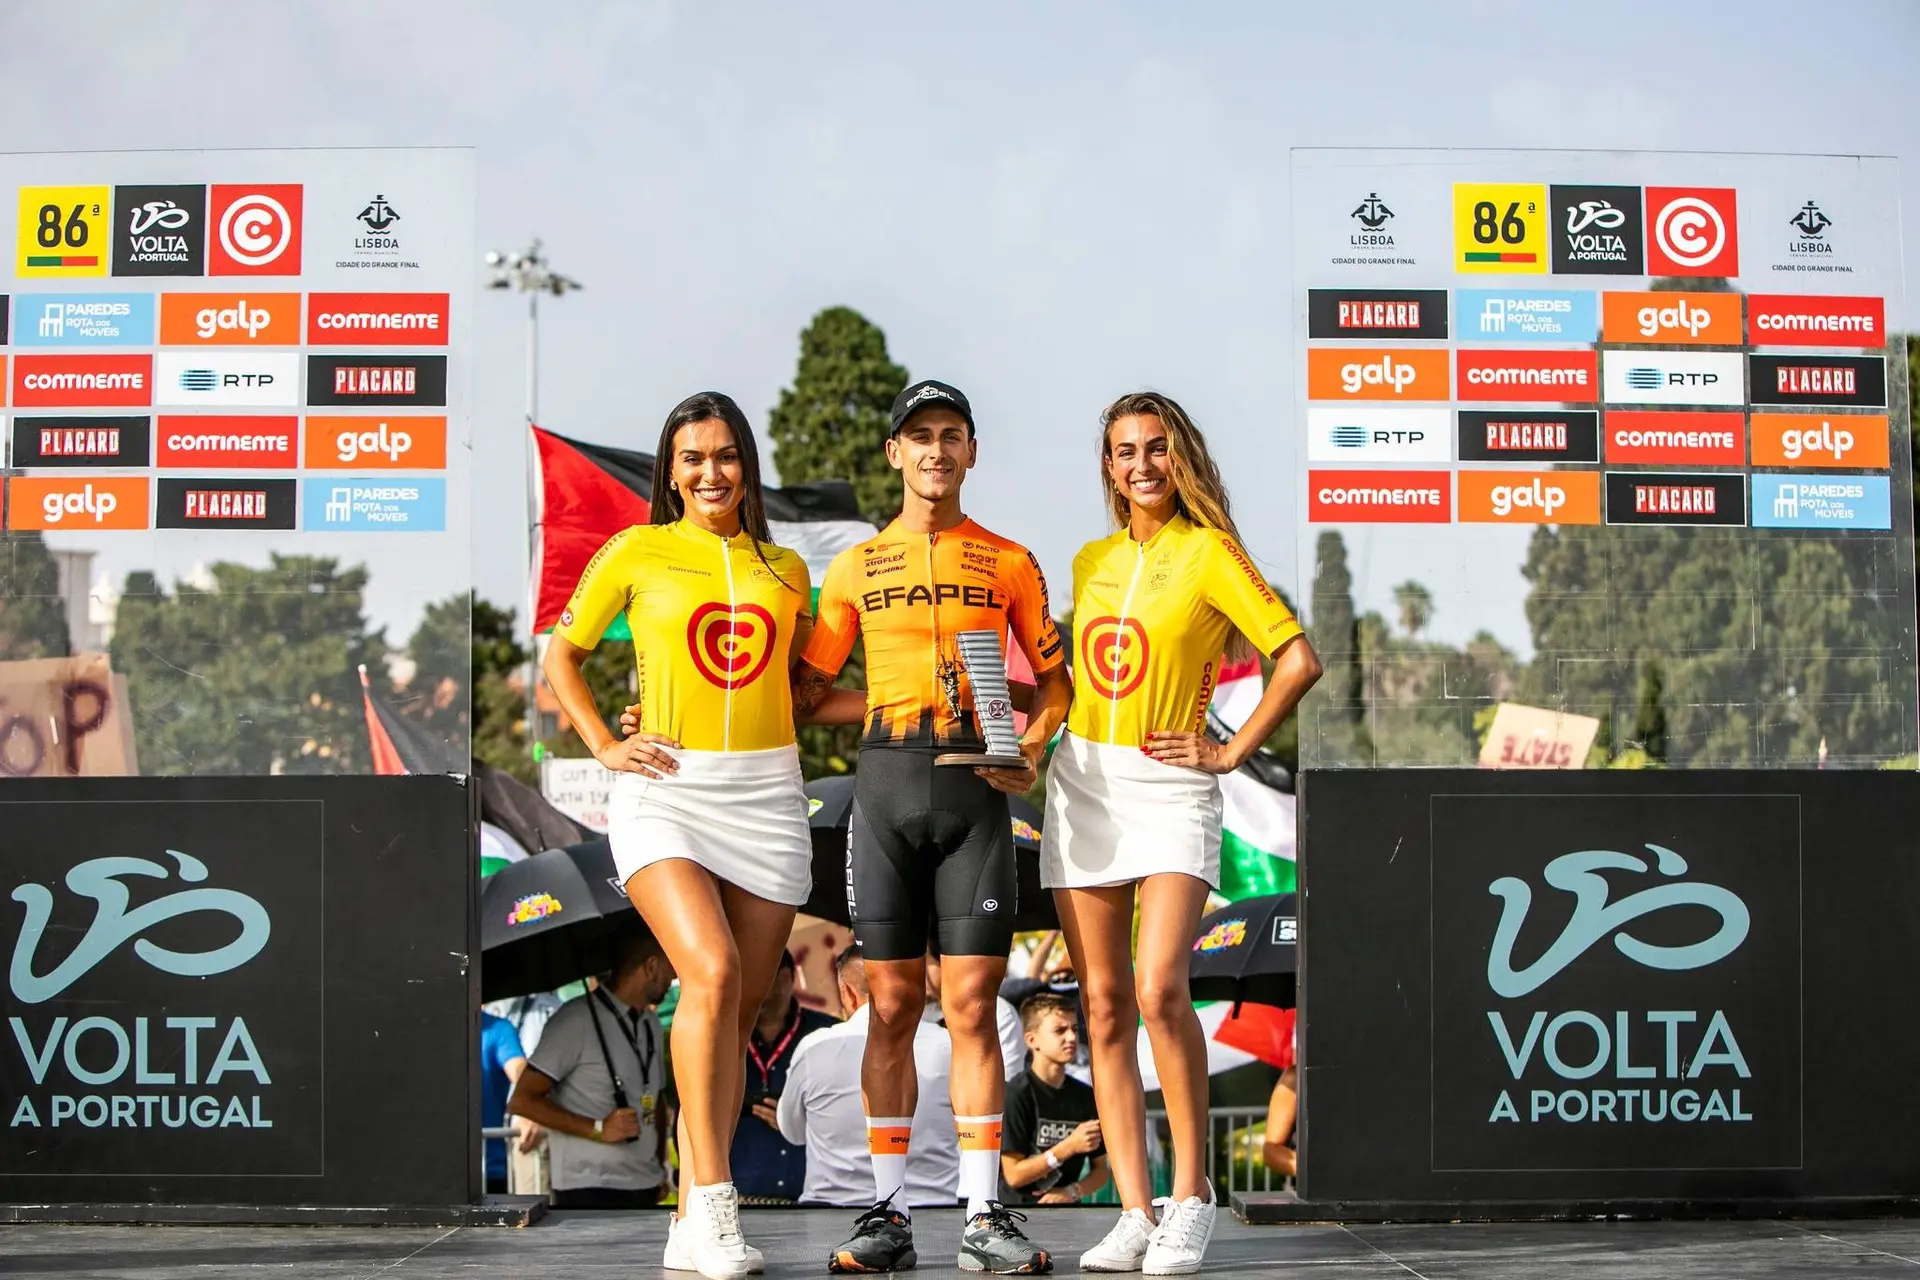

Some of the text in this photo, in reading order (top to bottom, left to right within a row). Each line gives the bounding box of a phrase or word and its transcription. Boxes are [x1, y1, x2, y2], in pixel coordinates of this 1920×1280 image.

[130, 236, 188, 252] VOLTA
[355, 239, 399, 248] LISBOA
[1351, 235, 1394, 245] LISBOA
[1567, 235, 1627, 251] VOLTA
[1790, 243, 1832, 253] LISBOA
[139, 253, 188, 261] PORTUGAL
[1578, 252, 1627, 261] PORTUGAL
[66, 304, 130, 315] PAREDES
[1507, 300, 1571, 312] PAREDES
[196, 301, 270, 337] galp
[318, 313, 438, 329] CONTINENTE
[1340, 302, 1419, 327] PLACARD
[1507, 314, 1535, 323] ROTA
[1638, 300, 1710, 337] galp
[1757, 314, 1873, 331] CONTINENTE
[66, 319, 93, 328] ROTA
[24, 374, 143, 389] CONTINENTE
[224, 374, 274, 387] RTP
[335, 368, 415, 393] PLACARD
[1341, 356, 1415, 393] galp
[1467, 368, 1587, 384] CONTINENTE
[1669, 373, 1718, 386] RTP
[1778, 367, 1855, 393] PLACARD
[41, 429, 119, 455] PLACARD
[168, 435, 288, 451] CONTINENTE
[337, 424, 411, 461] galp
[1374, 431, 1424, 444] RTP
[1487, 423, 1566, 449] PLACARD
[1615, 431, 1733, 448] CONTINENTE
[1782, 422, 1854, 459] galp
[353, 488, 419, 500] PAREDES
[1318, 488, 1440, 505] CONTINENTE
[1491, 478, 1565, 515] galp
[1800, 485, 1863, 497] PAREDES
[43, 485, 116, 522] galp
[186, 491, 266, 517] PLACARD
[353, 502, 381, 512] ROTA
[1636, 487, 1715, 513] PLACARD
[1800, 500, 1829, 508] ROTA
[862, 583, 1002, 612] EFAPEL
[0, 678, 111, 776] OP
[555, 792, 583, 804] ITH
[9, 1017, 271, 1084] VOLTA
[1487, 1010, 1751, 1079] VOLTA
[10, 1095, 272, 1127] A PORTUGAL
[1488, 1089, 1752, 1122] A PORTUGAL
